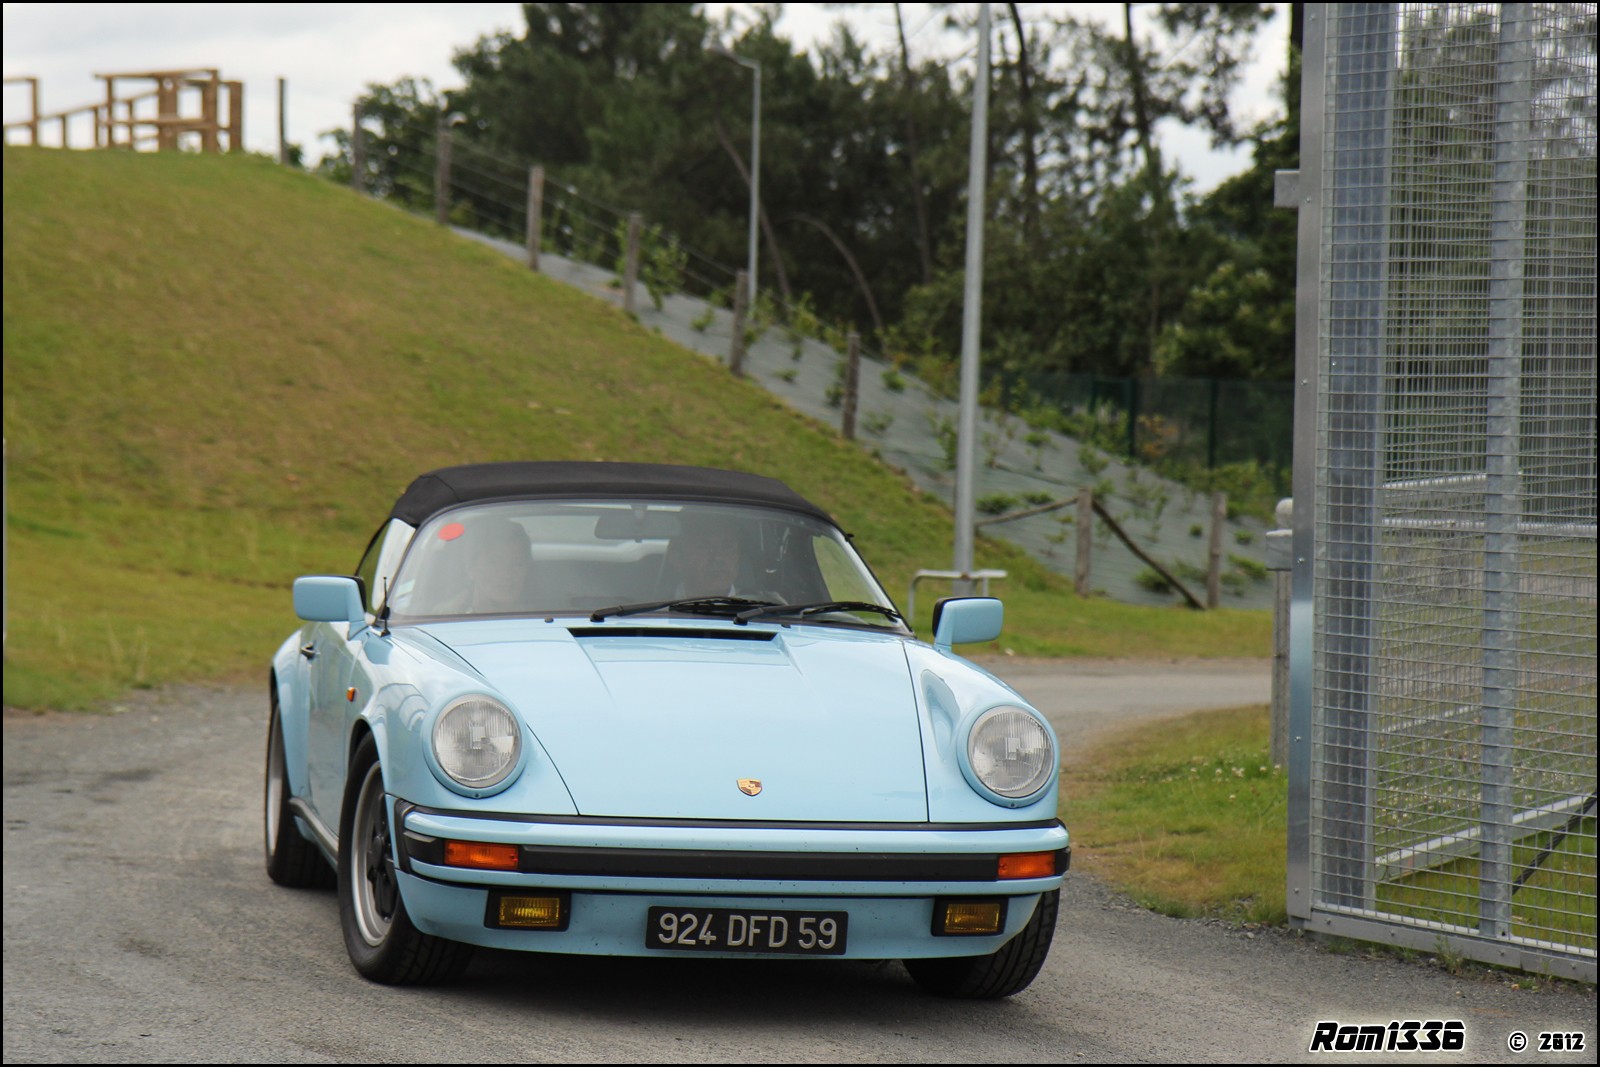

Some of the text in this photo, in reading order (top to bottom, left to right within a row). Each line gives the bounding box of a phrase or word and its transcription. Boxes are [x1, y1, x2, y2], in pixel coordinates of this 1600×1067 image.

[658, 913, 837, 949] 924 DFD 59
